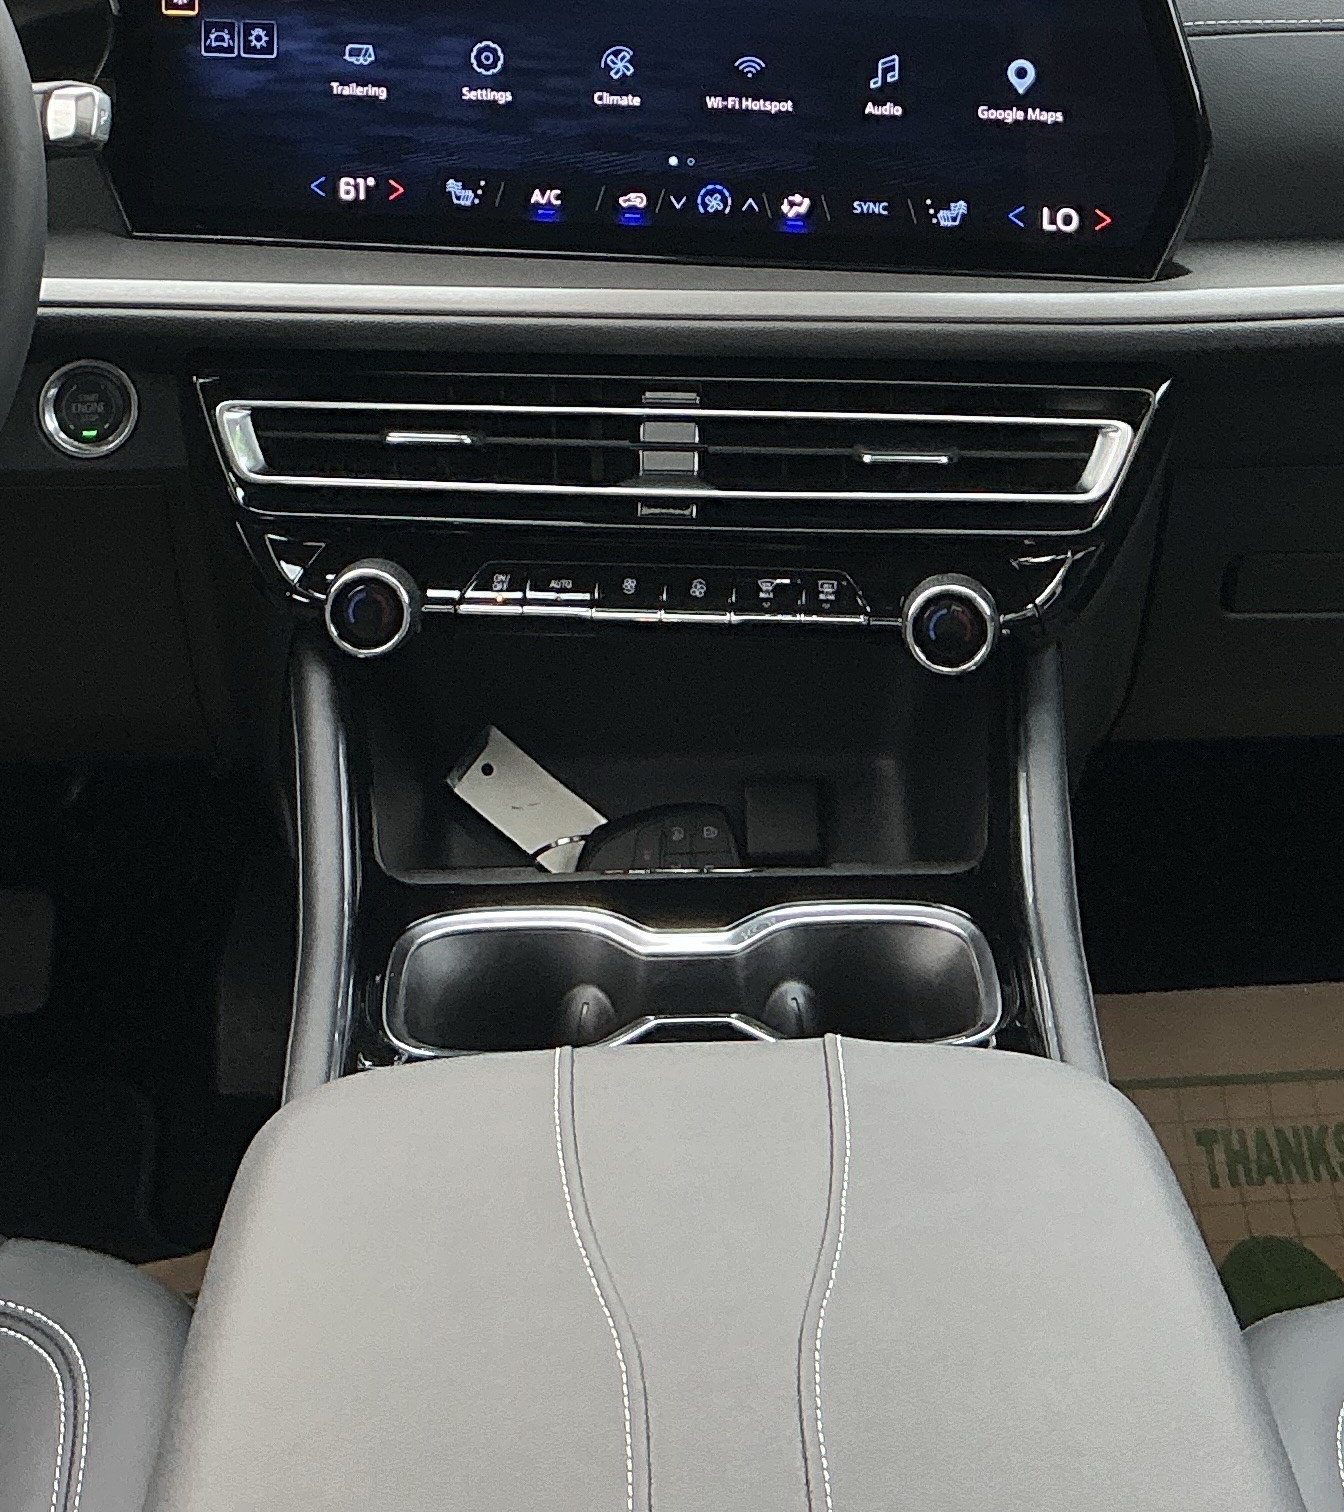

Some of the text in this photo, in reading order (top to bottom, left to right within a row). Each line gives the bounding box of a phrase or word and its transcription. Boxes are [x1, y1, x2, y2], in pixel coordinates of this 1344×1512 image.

[330, 81, 387, 100] Trailering
[461, 86, 513, 104] Settings
[593, 91, 642, 107] Climate
[705, 95, 794, 114] Wi-Fi Hotspot
[864, 101, 903, 117] Audio
[977, 105, 1064, 125] Google Maps
[530, 188, 562, 206] A/C
[852, 200, 889, 216] SYNC
[1041, 206, 1081, 233] LO
[549, 579, 573, 589] AUTO
